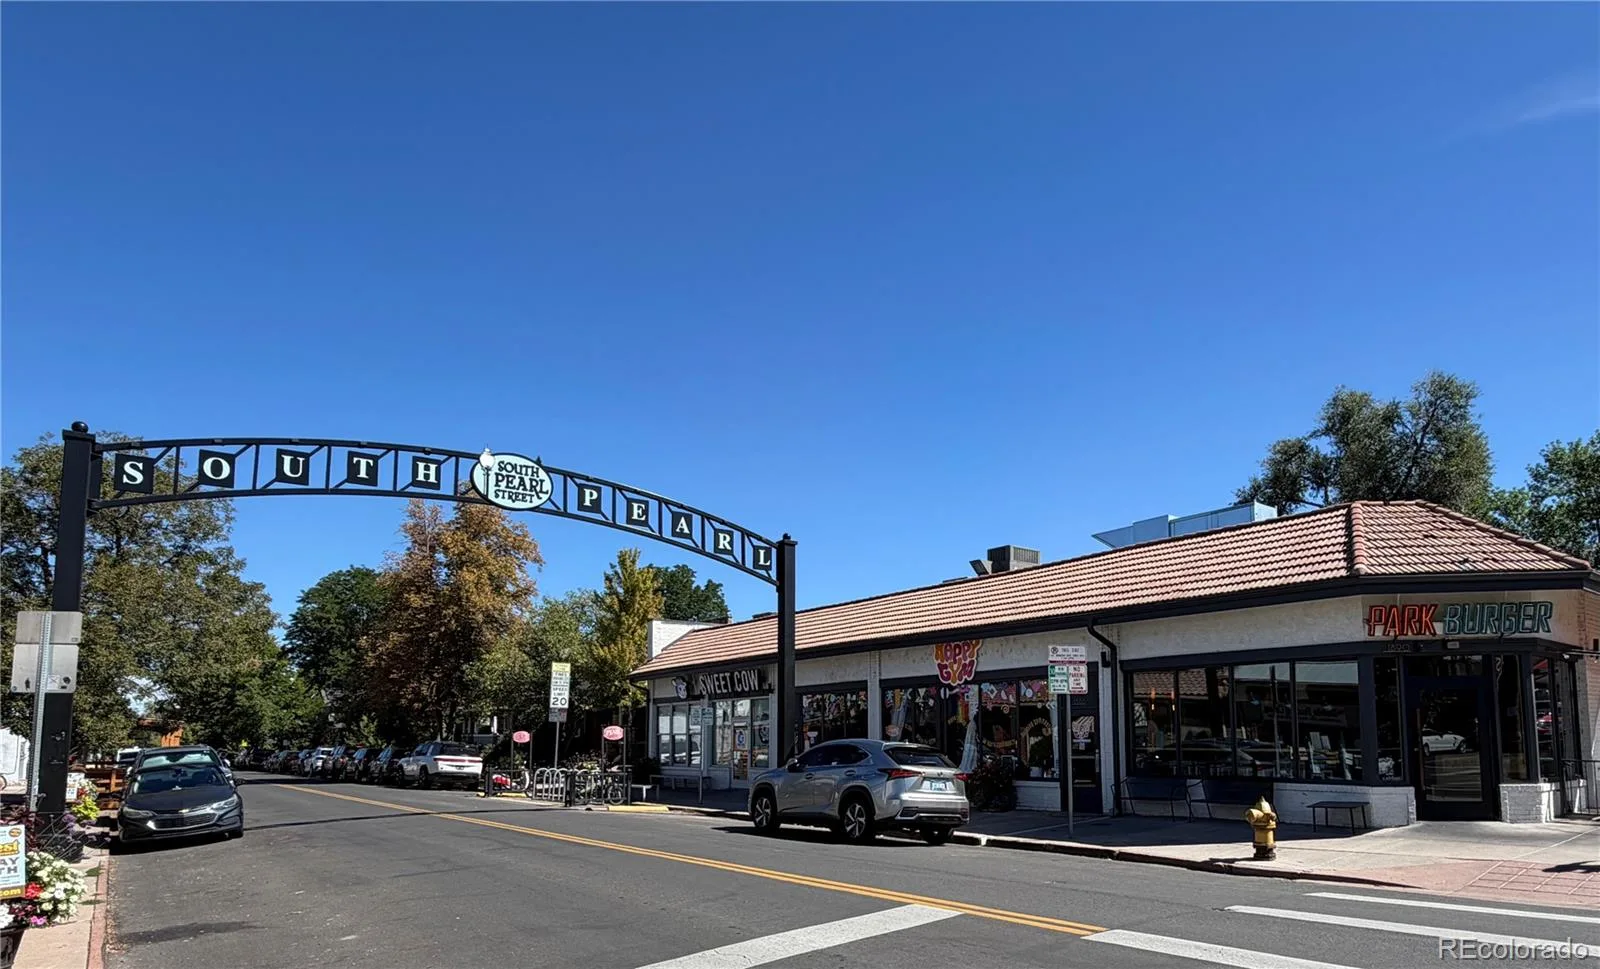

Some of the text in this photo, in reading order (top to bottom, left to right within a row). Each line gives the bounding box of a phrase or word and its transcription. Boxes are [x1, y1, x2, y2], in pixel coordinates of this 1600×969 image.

[497, 460, 540, 478] SOUTH
[494, 472, 549, 500] PEARL
[494, 489, 535, 503] STREET
[122, 454, 771, 566] SOUTH PEARL
[1367, 602, 1553, 637] PARK BURGER
[699, 669, 760, 695] SWEET COW
[552, 697, 567, 705] 20
